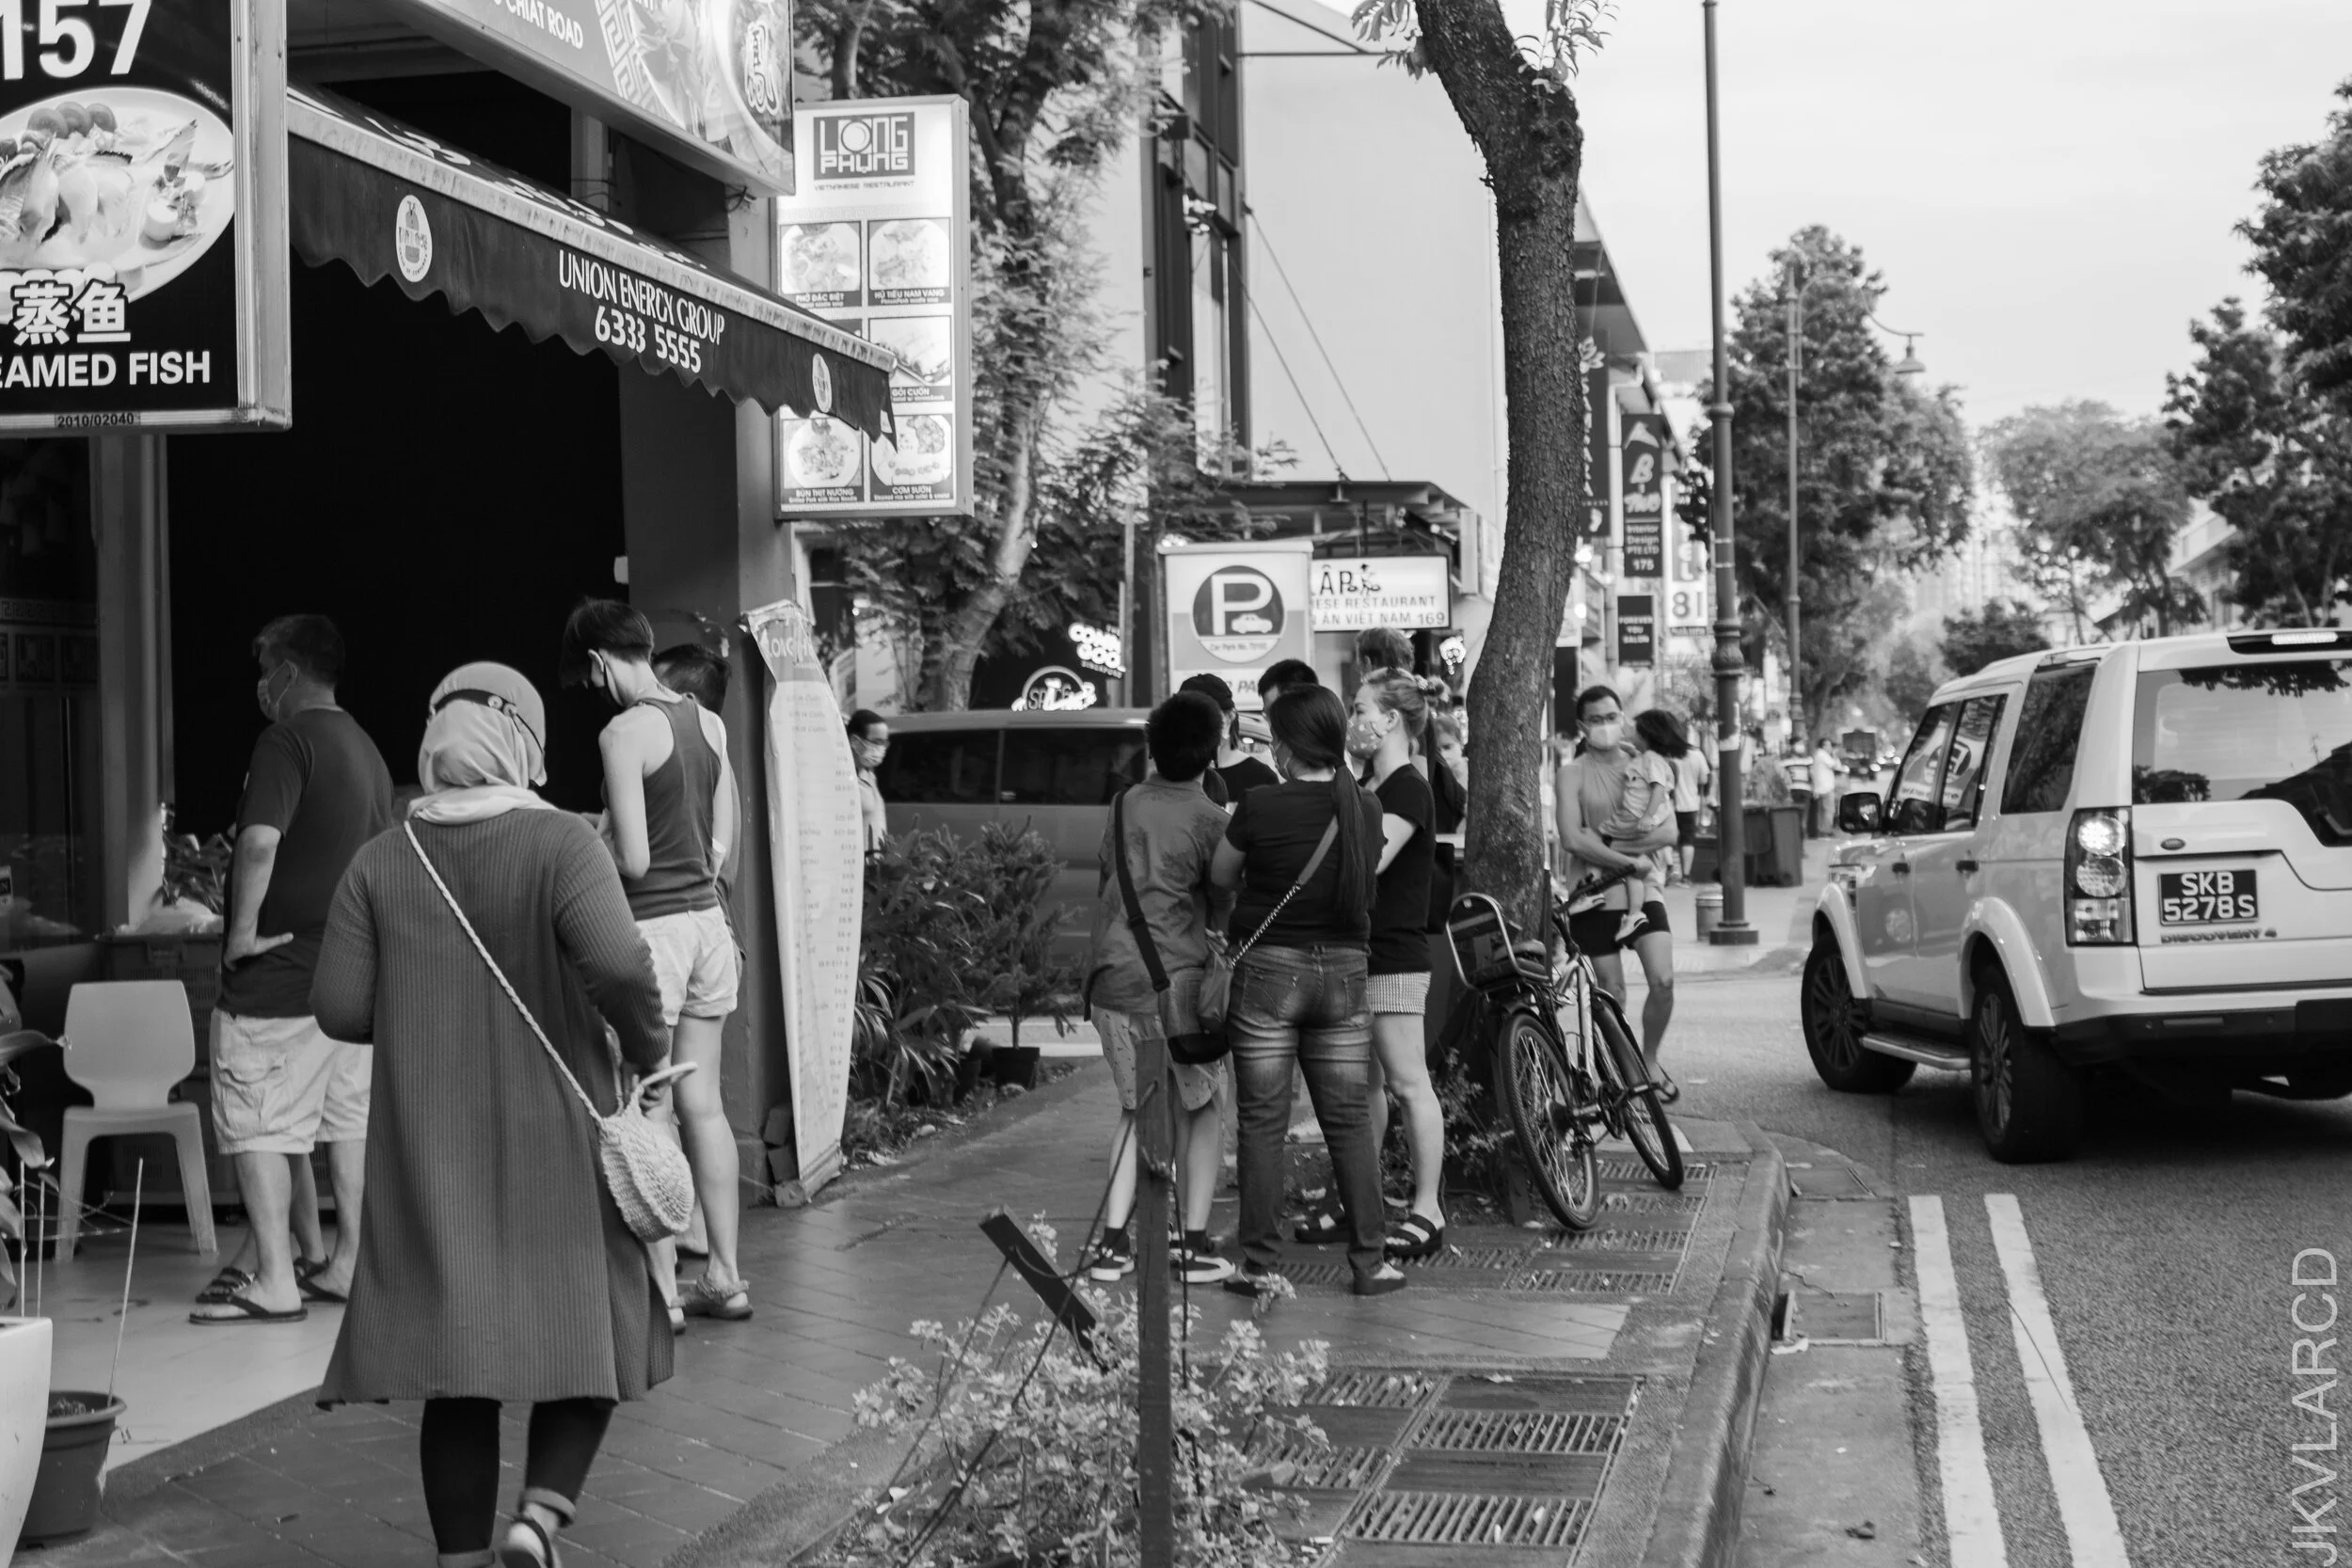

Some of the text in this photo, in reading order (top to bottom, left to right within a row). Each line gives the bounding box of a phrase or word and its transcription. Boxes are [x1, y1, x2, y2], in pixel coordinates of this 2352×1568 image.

[547, 6, 583, 49] ROAD
[559, 249, 617, 304] UNION
[676, 297, 725, 345] GROUP
[13, 280, 131, 346] 蒸鱼
[595, 306, 702, 373] 6333 5555
[0, 350, 210, 388] AMED FISH
[57, 412, 134, 428] 2010/02040
[1627, 525, 1660, 533] Interior
[1627, 535, 1660, 546] Design
[1211, 574, 1273, 635] P
[1345, 595, 1436, 608] RESTAURANT
[1380, 612, 1411, 625] NAM
[1418, 611, 1446, 626] 169
[1618, 616, 1654, 625] FOREVER
[2181, 871, 2234, 896] SKB
